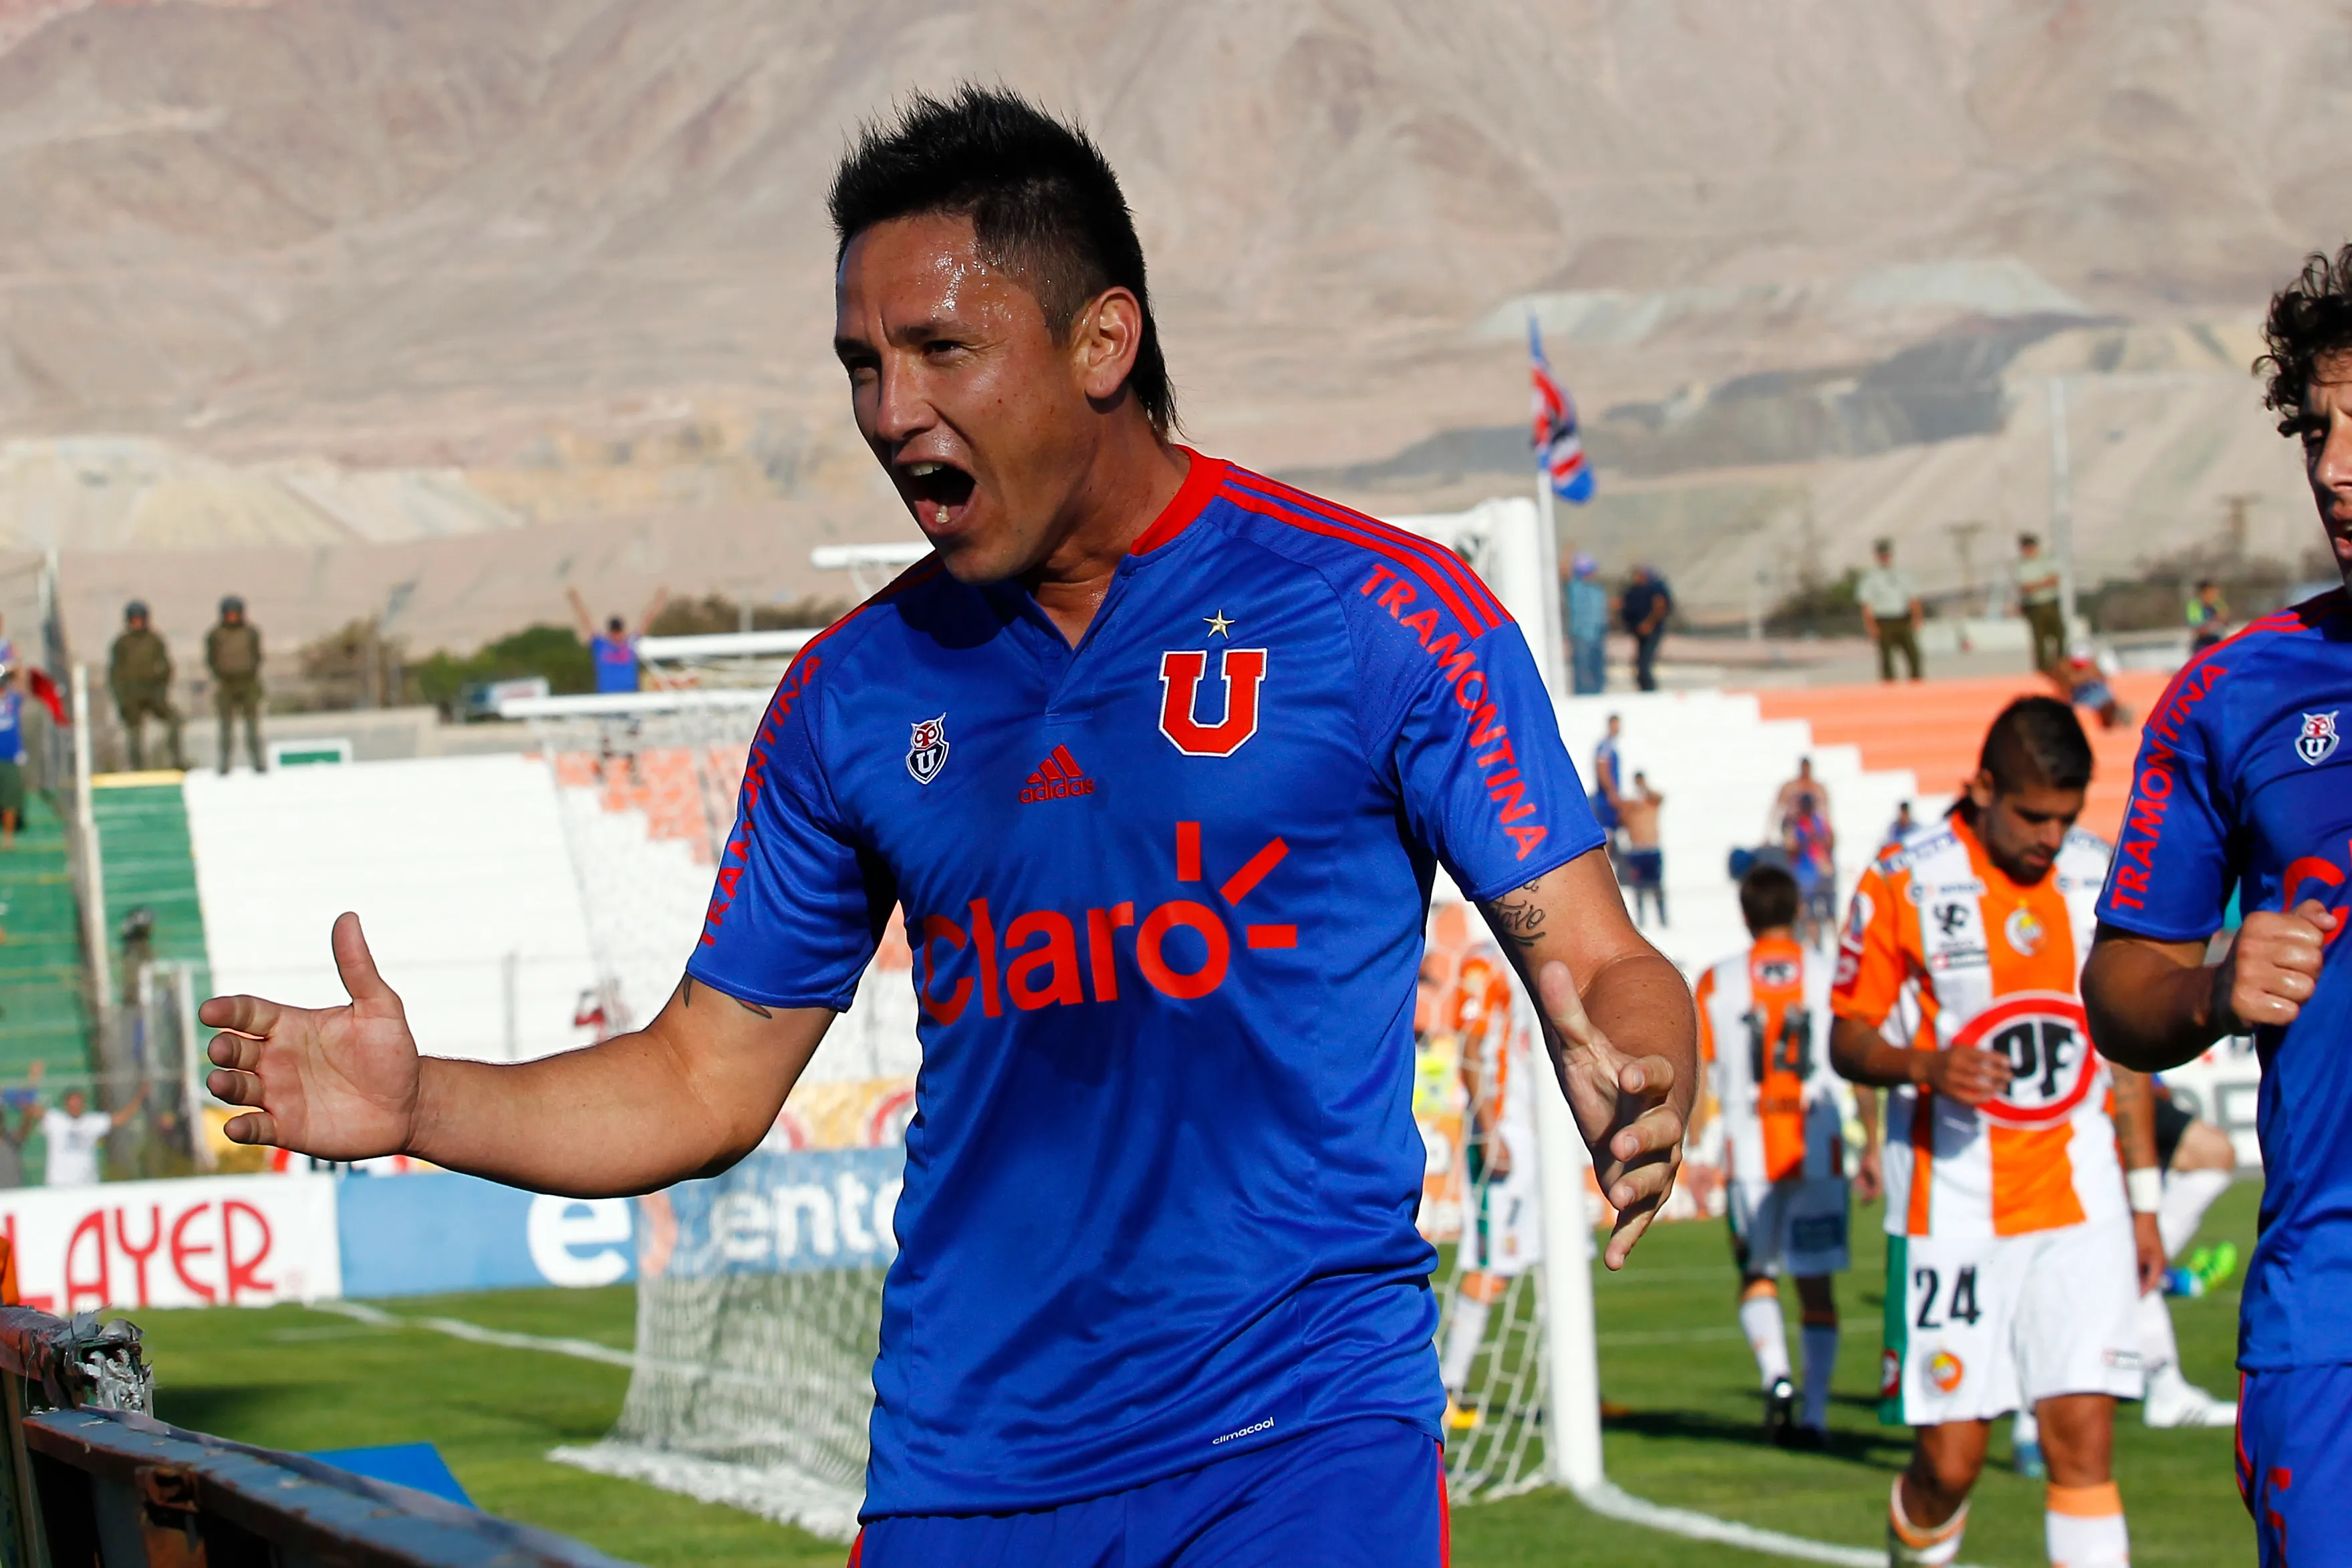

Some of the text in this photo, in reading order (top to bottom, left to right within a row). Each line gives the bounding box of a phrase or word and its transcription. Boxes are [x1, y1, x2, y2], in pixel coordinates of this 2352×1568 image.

[1158, 647, 1269, 758] U
[1359, 563, 1548, 862] TRAMONTINA
[916, 748, 936, 774] U
[2305, 739, 2327, 757] U
[1019, 775, 1095, 804] adidas
[2110, 664, 2229, 910] TRAMONTINA
[1742, 1005, 1816, 1083] 14
[1915, 1267, 1983, 1329] 24
[1212, 1416, 1275, 1445] climacool
